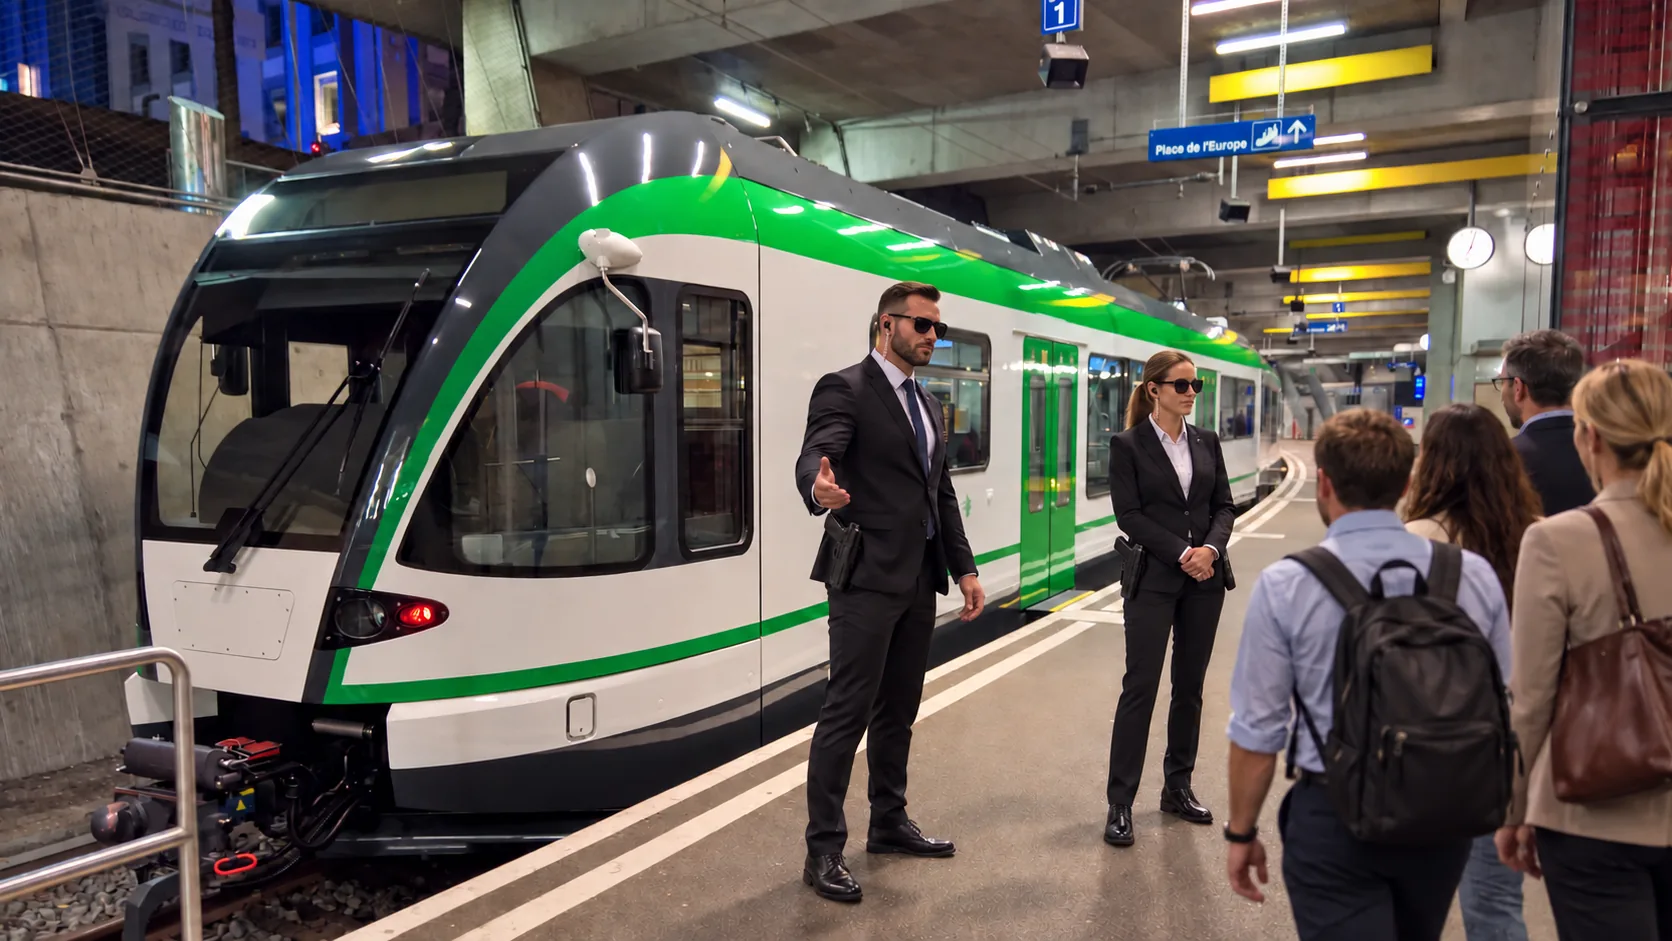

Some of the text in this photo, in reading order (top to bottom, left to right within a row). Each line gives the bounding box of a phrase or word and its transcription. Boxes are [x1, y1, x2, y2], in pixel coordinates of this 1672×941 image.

[1054, 1, 1064, 24] 1
[1155, 139, 1247, 156] Place de l'Europe
